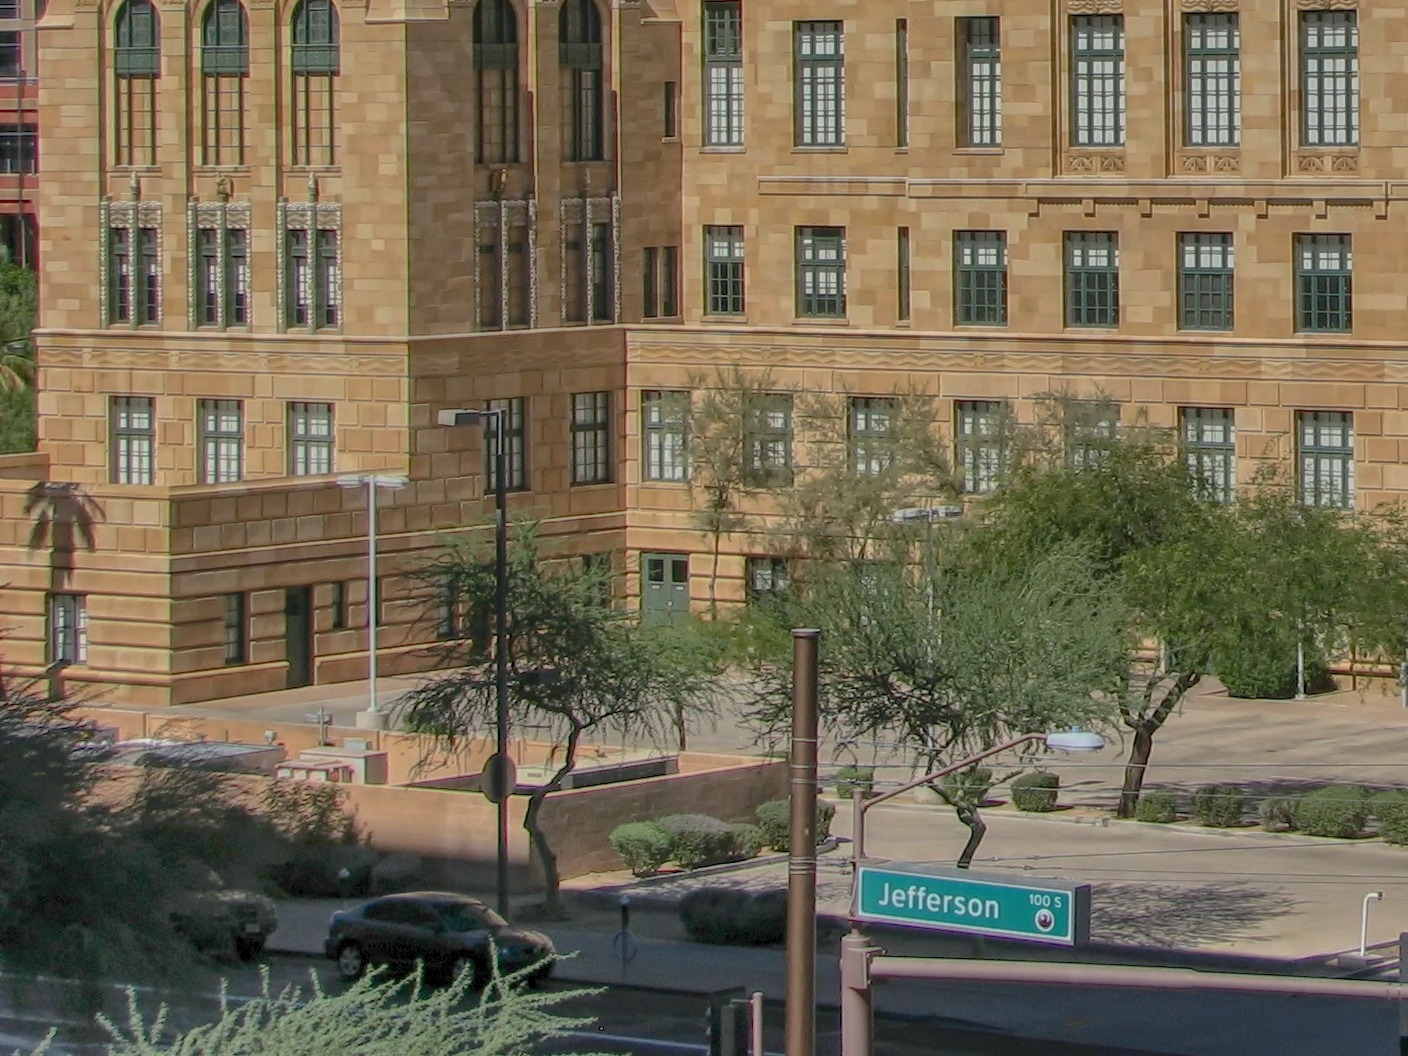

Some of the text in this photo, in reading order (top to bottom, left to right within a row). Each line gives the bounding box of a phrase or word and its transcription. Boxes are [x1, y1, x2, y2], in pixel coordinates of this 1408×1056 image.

[878, 882, 999, 919] Jefferson
[1028, 893, 1062, 908] 100 S
